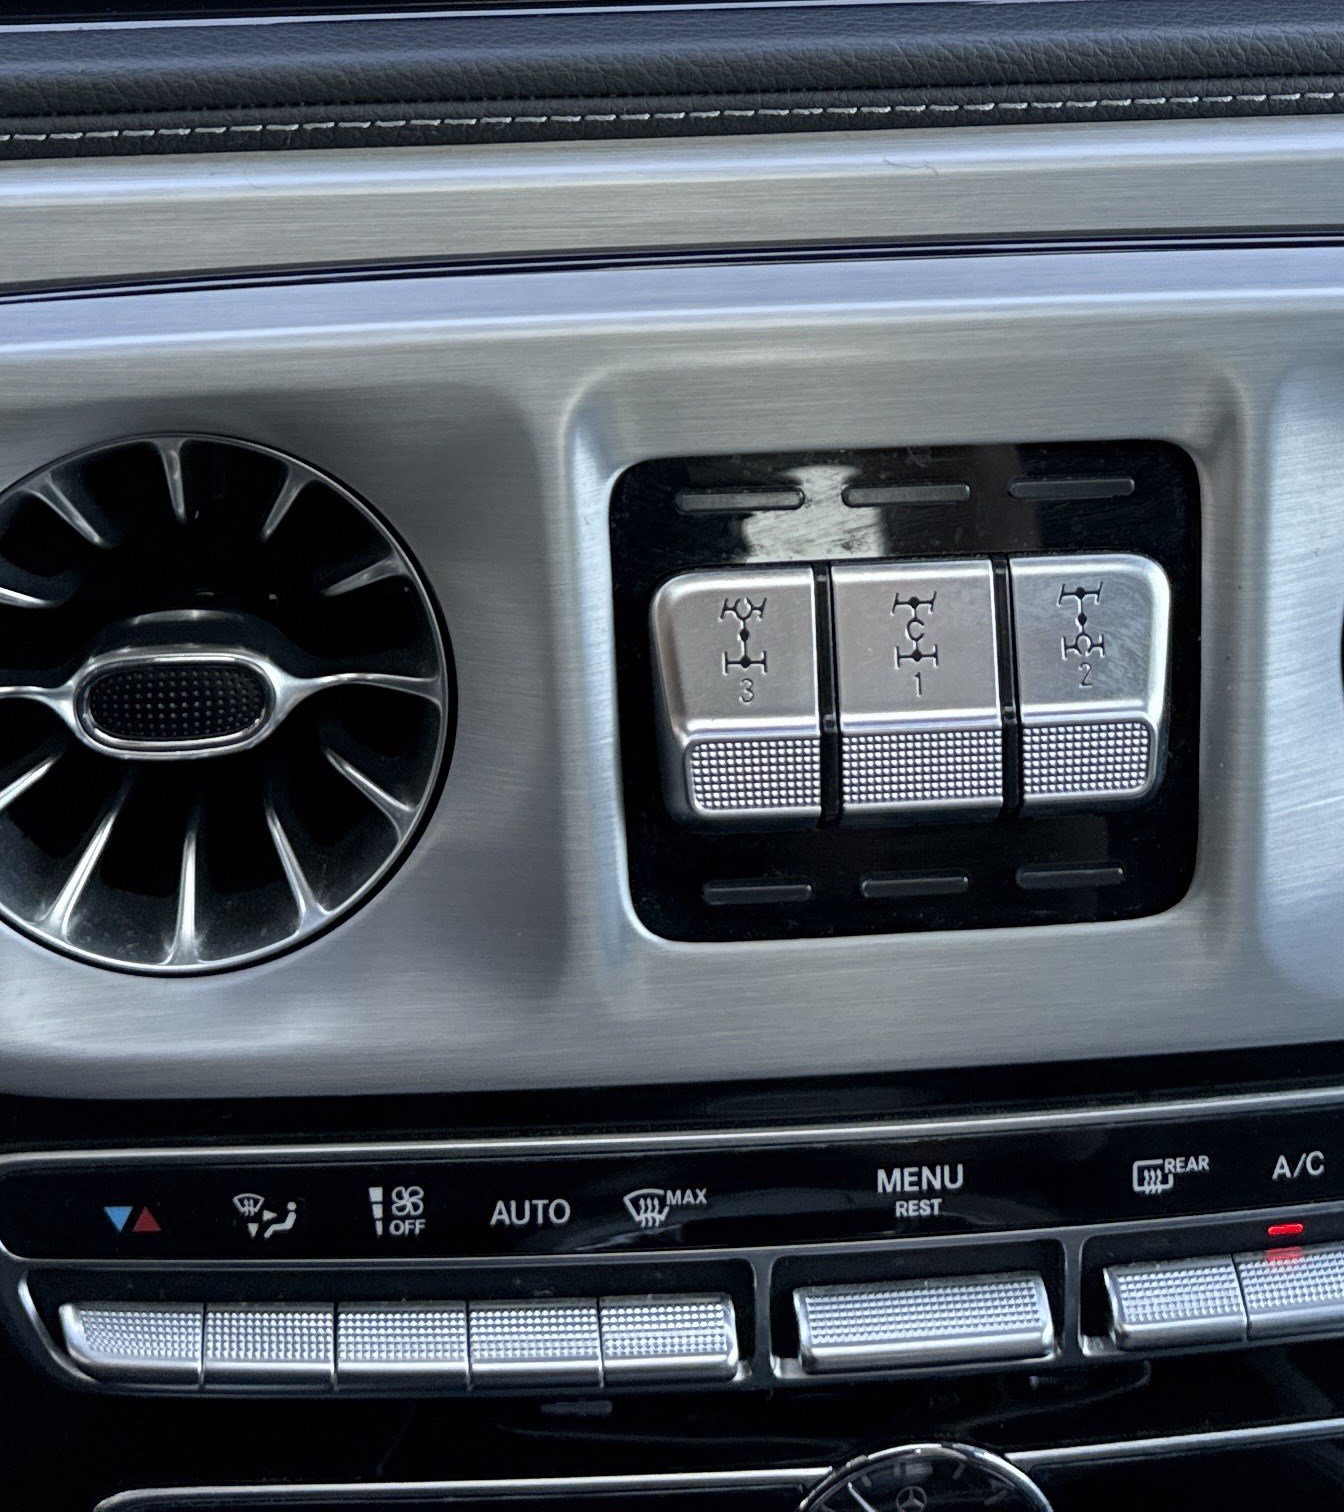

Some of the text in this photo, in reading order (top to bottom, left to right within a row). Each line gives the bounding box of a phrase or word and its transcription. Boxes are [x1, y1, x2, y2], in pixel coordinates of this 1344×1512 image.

[1078, 662, 1092, 687] 2
[739, 678, 755, 704] 3
[1163, 1153, 1210, 1173] REAR
[1271, 1150, 1326, 1179] A/C
[876, 1164, 965, 1194] MENU
[666, 1189, 707, 1205] MAX
[894, 1198, 943, 1218] REST
[490, 1199, 571, 1227] AUTO
[389, 1219, 426, 1236] OFF
